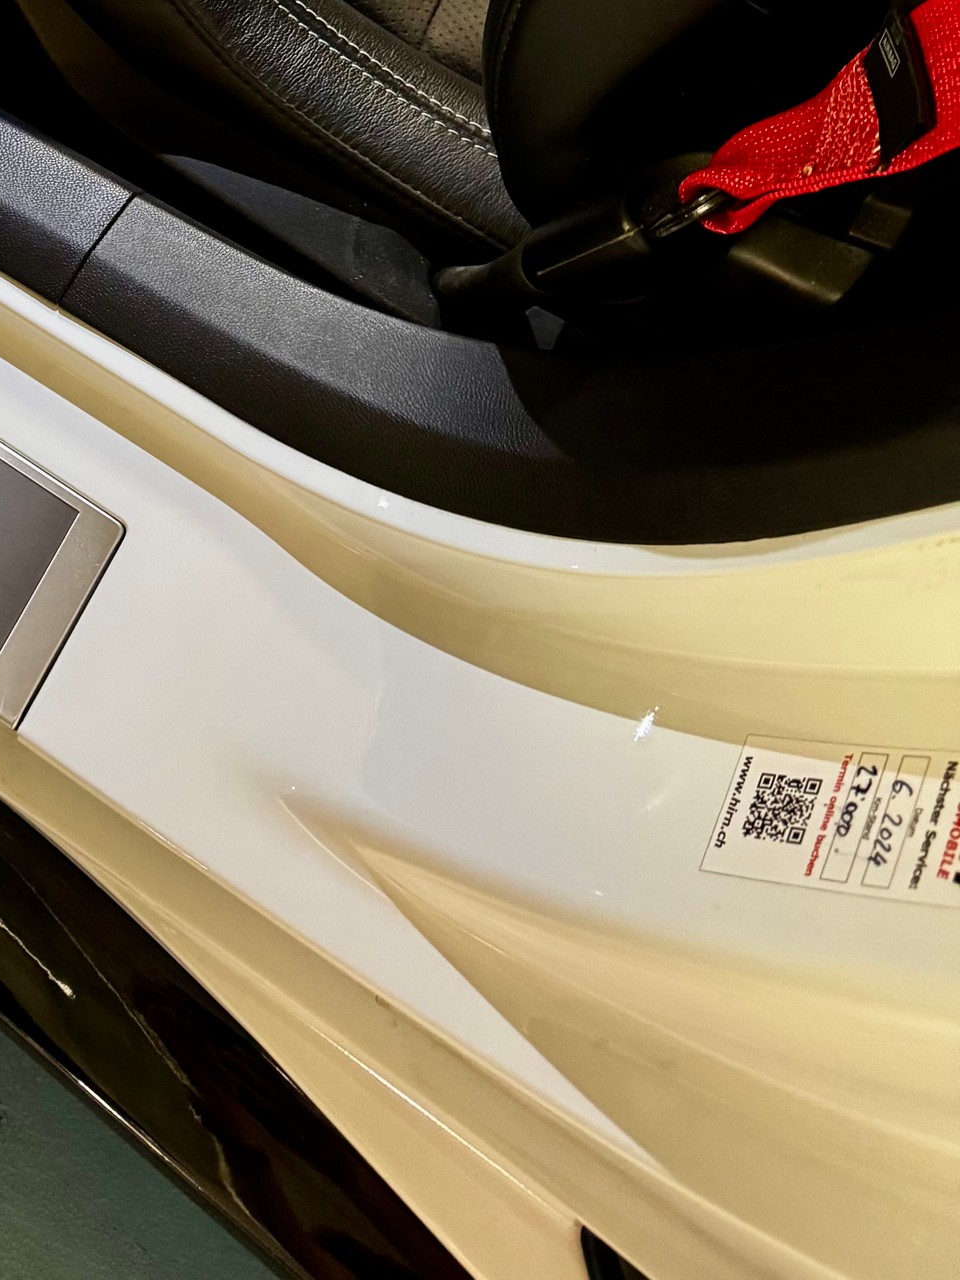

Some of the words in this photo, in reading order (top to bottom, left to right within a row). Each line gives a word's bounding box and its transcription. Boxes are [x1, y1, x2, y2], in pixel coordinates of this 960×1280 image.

[834, 753, 854, 792] Termin
[929, 760, 959, 826] Nächster
[714, 756, 753, 849] www.hirn.ch
[820, 796, 837, 831] online
[804, 834, 826, 877] buchen
[867, 813, 903, 867] 2024
